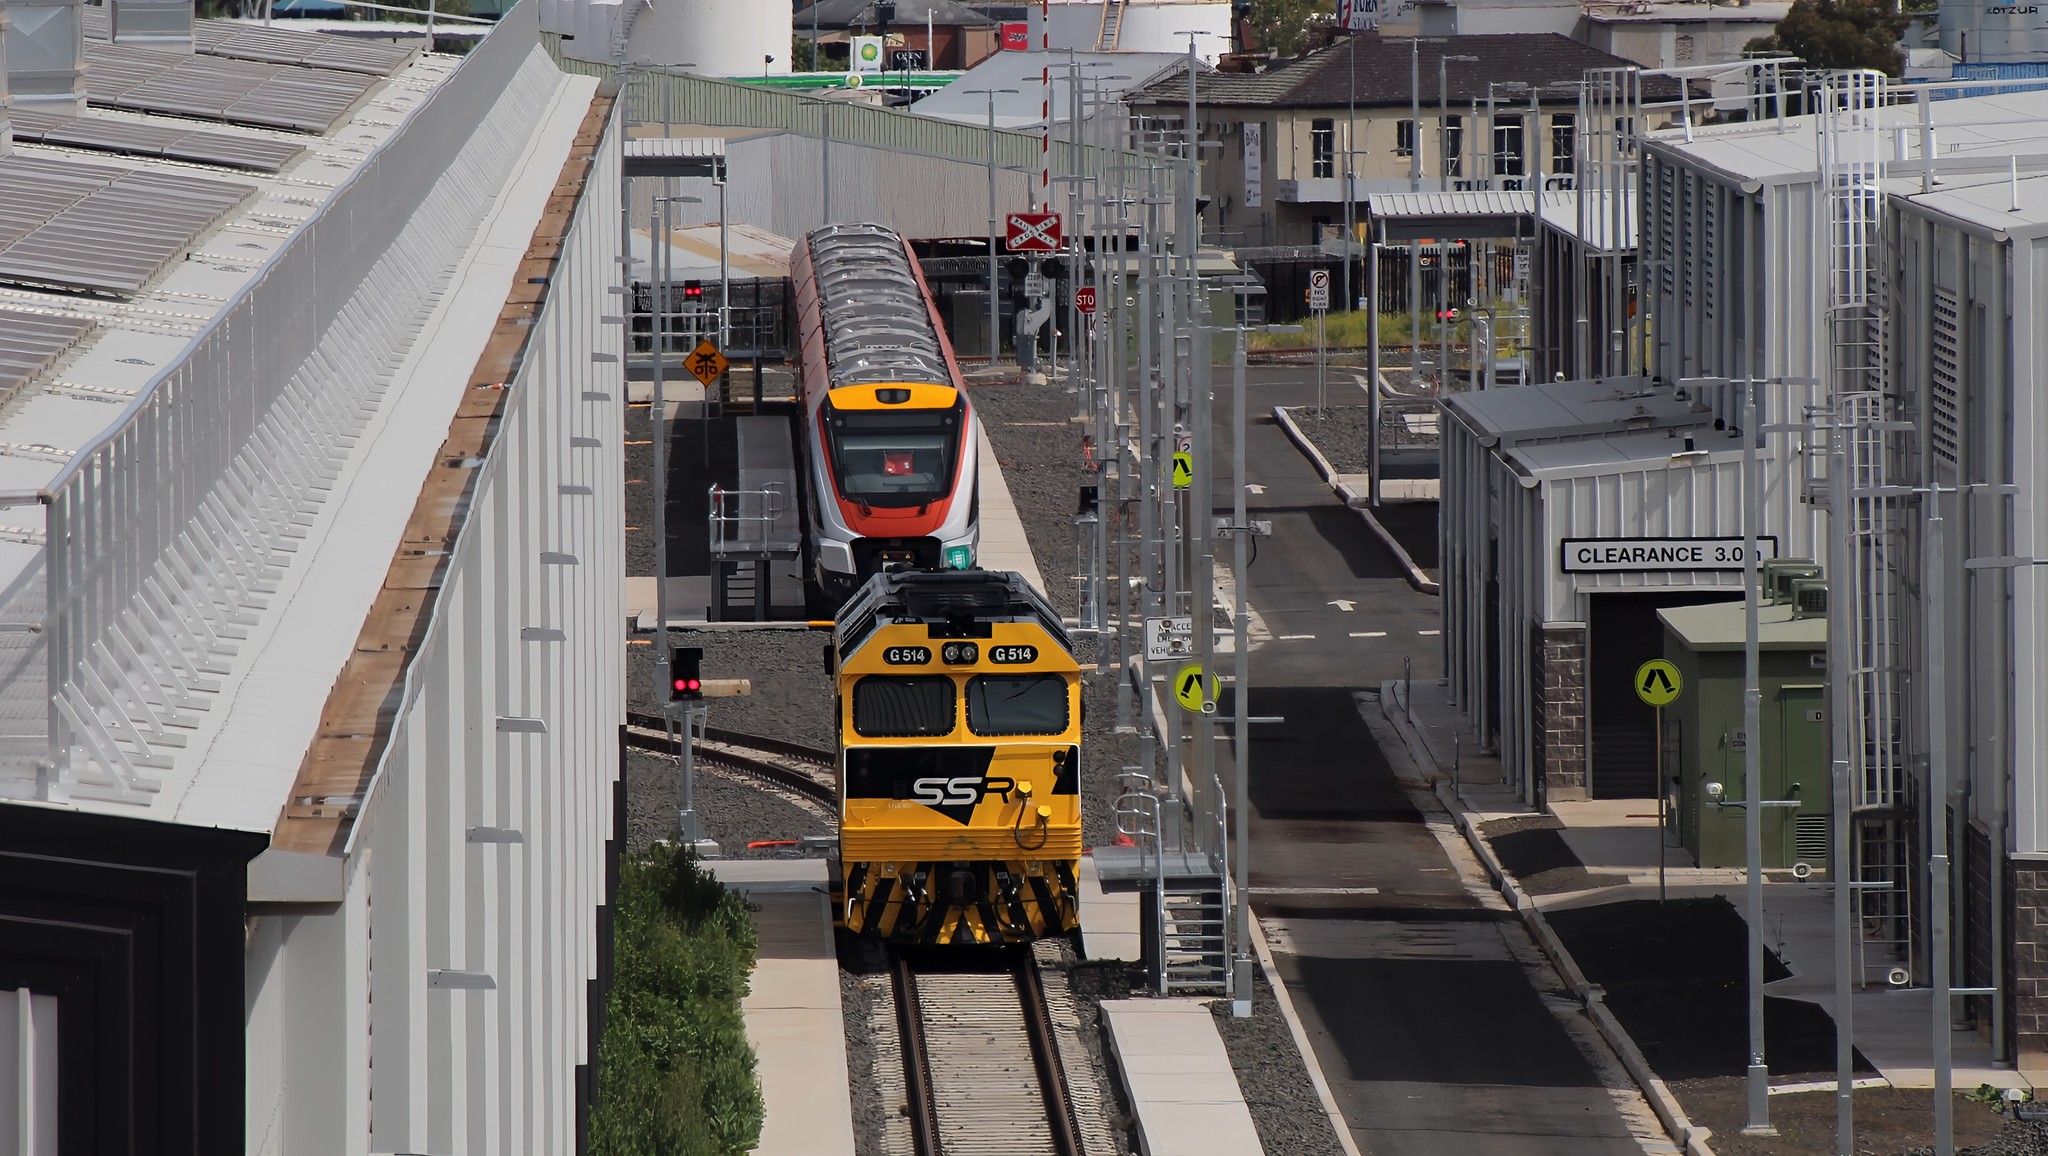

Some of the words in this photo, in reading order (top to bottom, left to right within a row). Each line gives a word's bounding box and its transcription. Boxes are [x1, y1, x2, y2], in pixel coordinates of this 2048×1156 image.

[1076, 295, 1094, 305] STO
[1577, 547, 1703, 563] CLEARANCE
[889, 649, 900, 661] G
[902, 649, 925, 662] 514
[995, 648, 1006, 660] G
[1008, 648, 1031, 660] 514
[913, 777, 1015, 805] SSR
